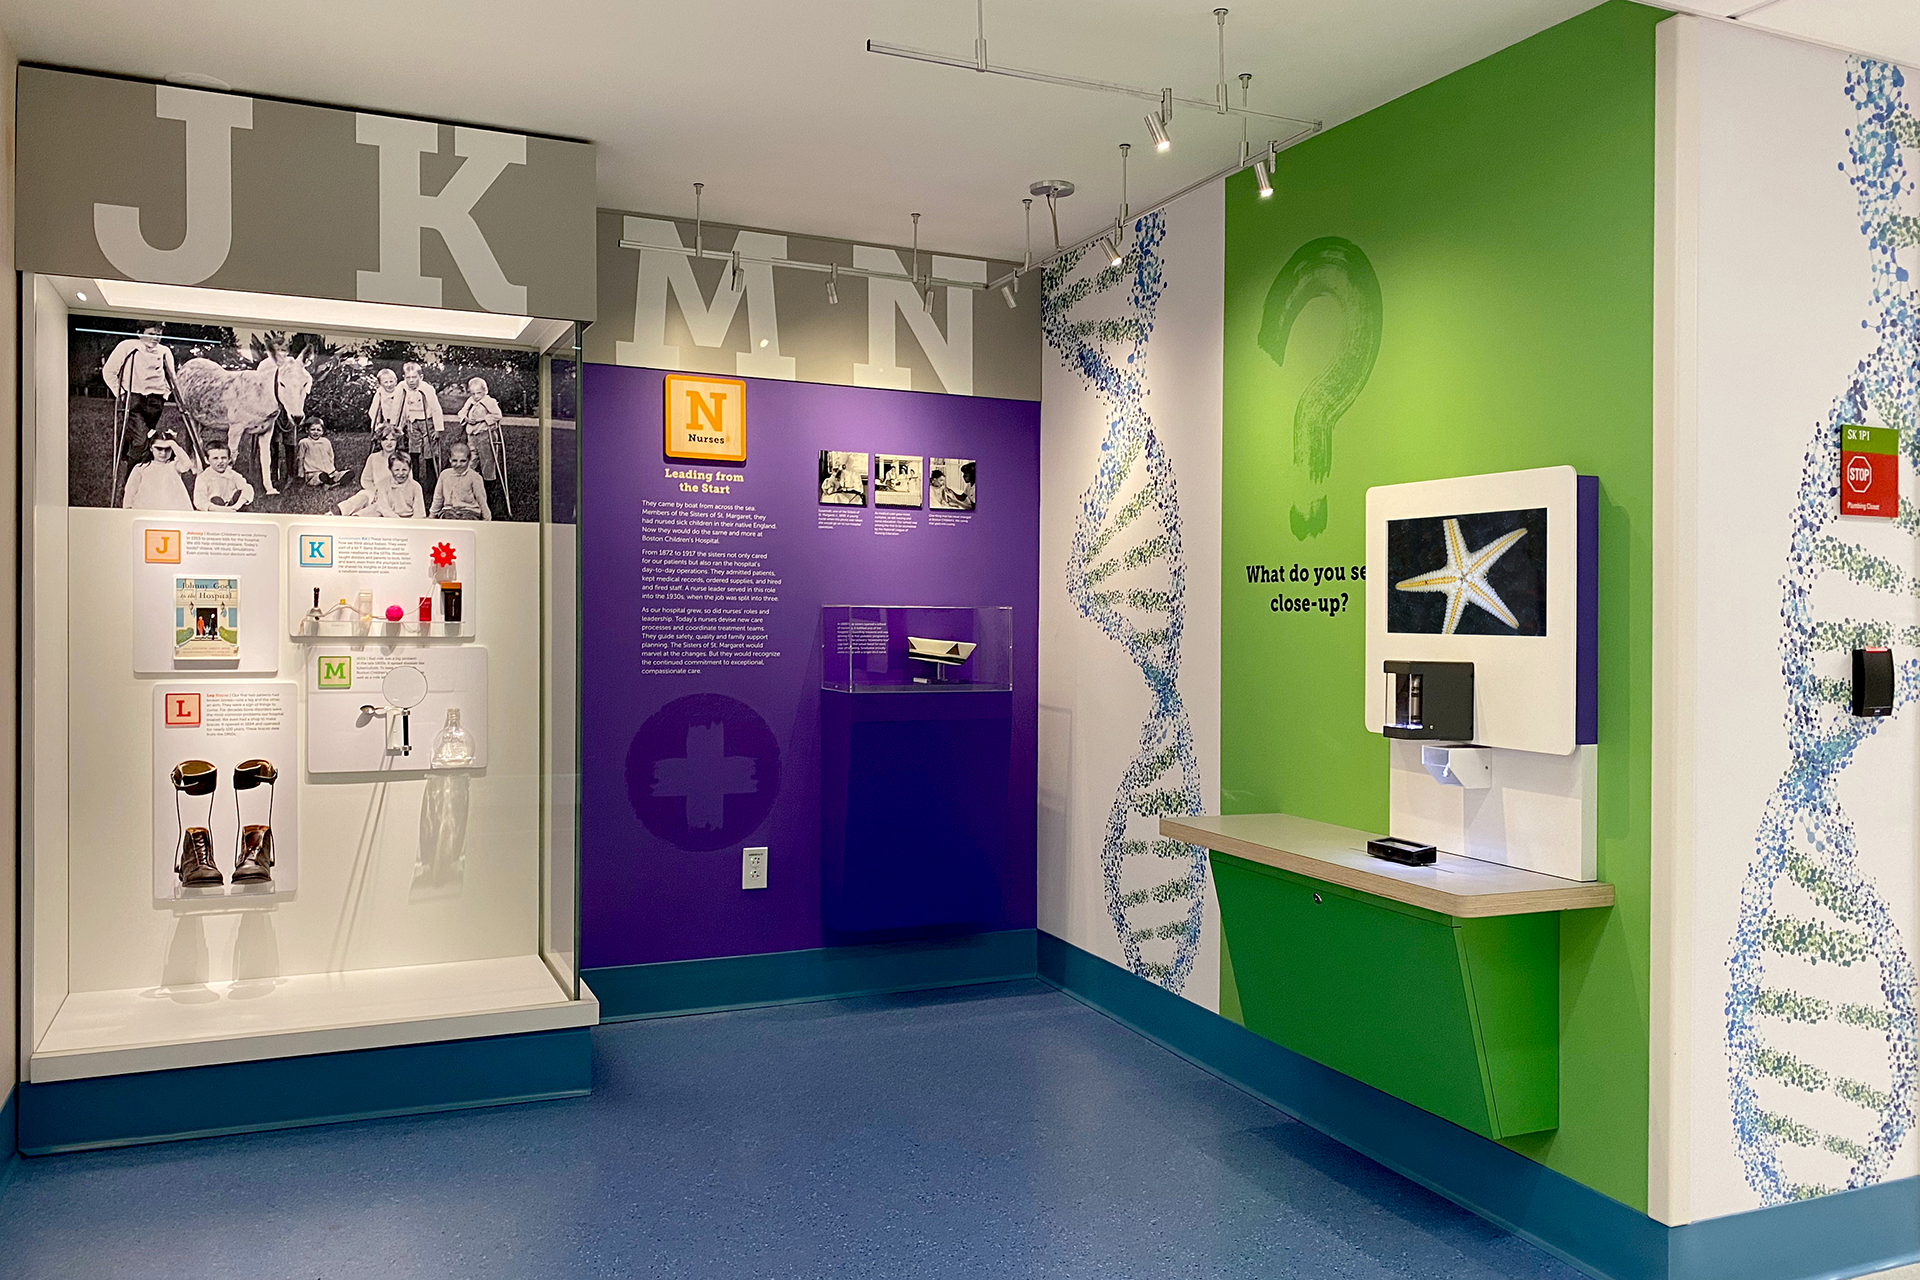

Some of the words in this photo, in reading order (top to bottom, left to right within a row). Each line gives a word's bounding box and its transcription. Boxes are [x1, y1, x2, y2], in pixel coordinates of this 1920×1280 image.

[94, 84, 253, 285] J
[355, 112, 528, 315] K
[615, 216, 797, 379] M
[852, 244, 988, 395] N
[686, 390, 727, 432] N
[688, 434, 725, 444] Nurses
[1847, 429, 1857, 440] SK
[1859, 430, 1870, 441] 1P1
[664, 468, 713, 482] Leading
[716, 471, 744, 482] from
[1849, 467, 1870, 481] STOP
[679, 483, 699, 492] the
[702, 483, 730, 494] Start
[642, 500, 657, 509] They
[754, 512, 766, 521] they
[658, 527, 671, 536] they
[156, 537, 169, 554] J
[309, 541, 324, 558] K
[738, 552, 751, 560] only
[664, 558, 687, 567] patients
[642, 566, 675, 576] day-to-day
[711, 568, 725, 577] They
[1246, 565, 1285, 583] What
[1289, 563, 1309, 582] do
[1313, 566, 1346, 586] you
[1350, 565, 1366, 581] se
[642, 575, 655, 584] kept
[182, 582, 209, 591] Johnny
[199, 592, 232, 601] Hospital
[715, 594, 724, 602] job
[738, 594, 749, 603] split
[1270, 592, 1349, 617] close-up?
[662, 607, 685, 616] hospital
[642, 625, 671, 633] processes
[642, 633, 657, 641] They
[658, 633, 674, 641] guide
[696, 633, 715, 642] quality
[728, 633, 745, 642] family
[747, 633, 768, 642] support
[719, 642, 744, 650] Margaret
[720, 650, 732, 659] they
[753, 650, 780, 659] recognize
[324, 663, 346, 679] M
[641, 668, 686, 676] compassionate
[176, 700, 191, 717] L
